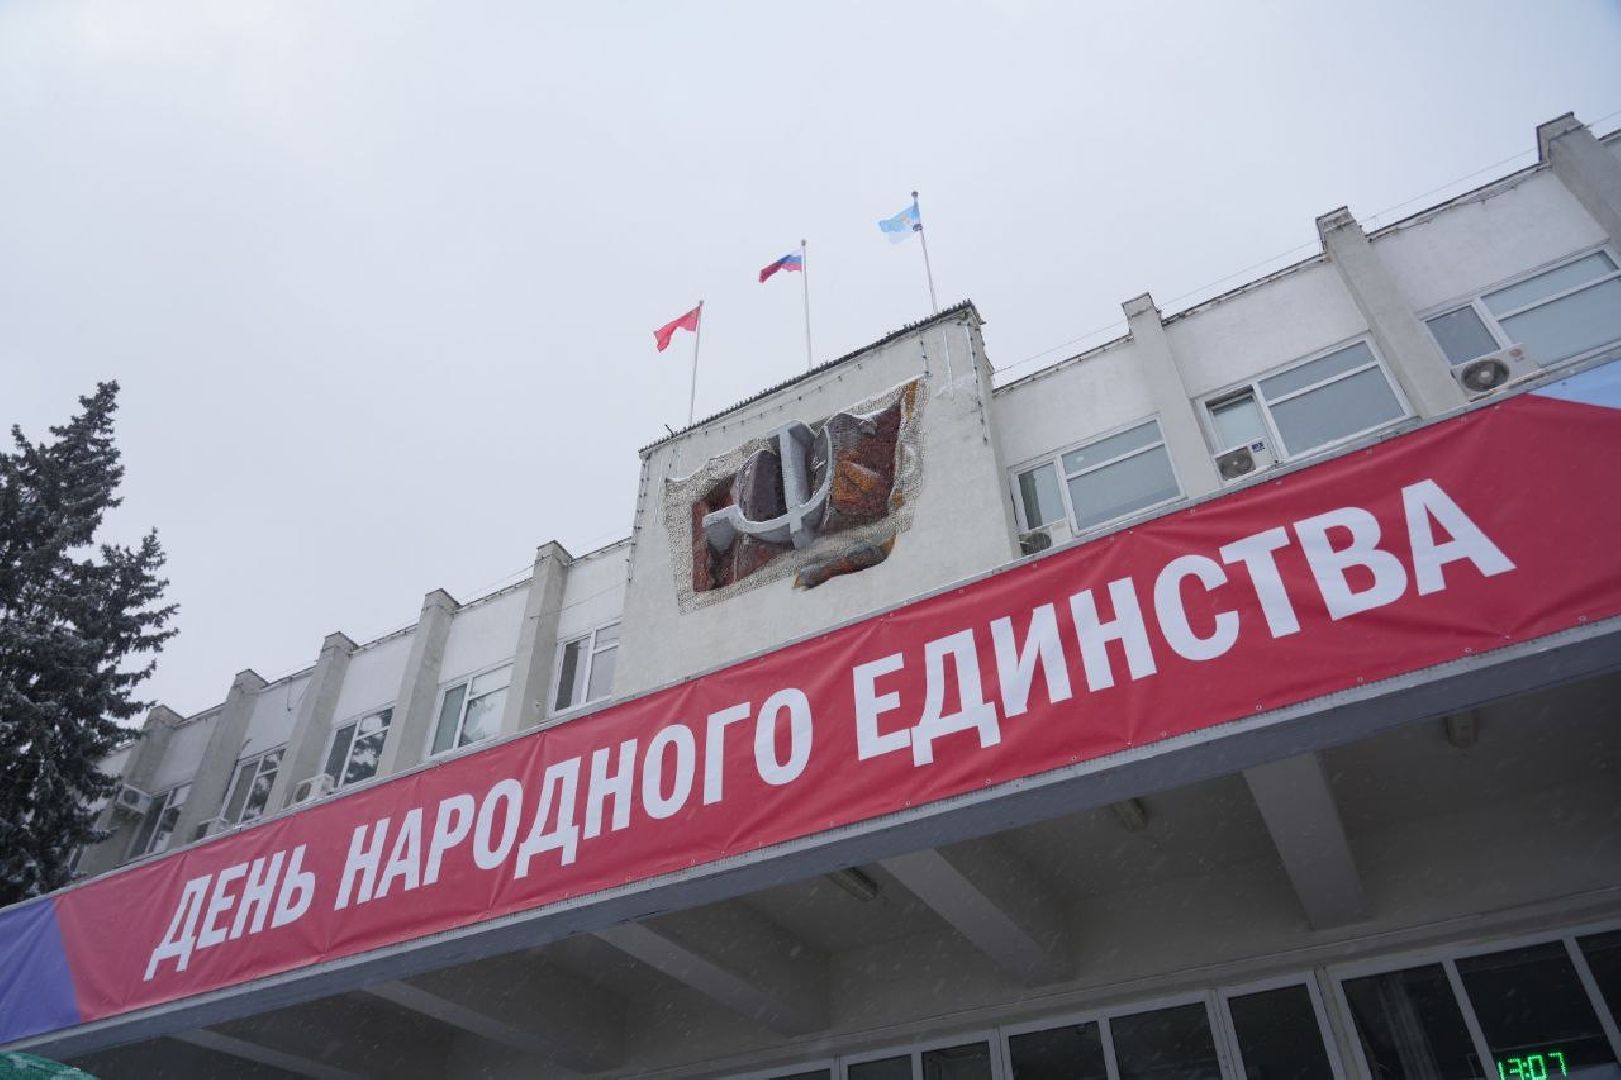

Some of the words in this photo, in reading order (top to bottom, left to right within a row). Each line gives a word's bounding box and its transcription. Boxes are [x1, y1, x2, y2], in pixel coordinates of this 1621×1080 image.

[143, 843, 316, 982] ДЕНЬ
[334, 687, 814, 911] НАРОДНОГО
[852, 479, 1516, 767] ЕДИНСТВА
